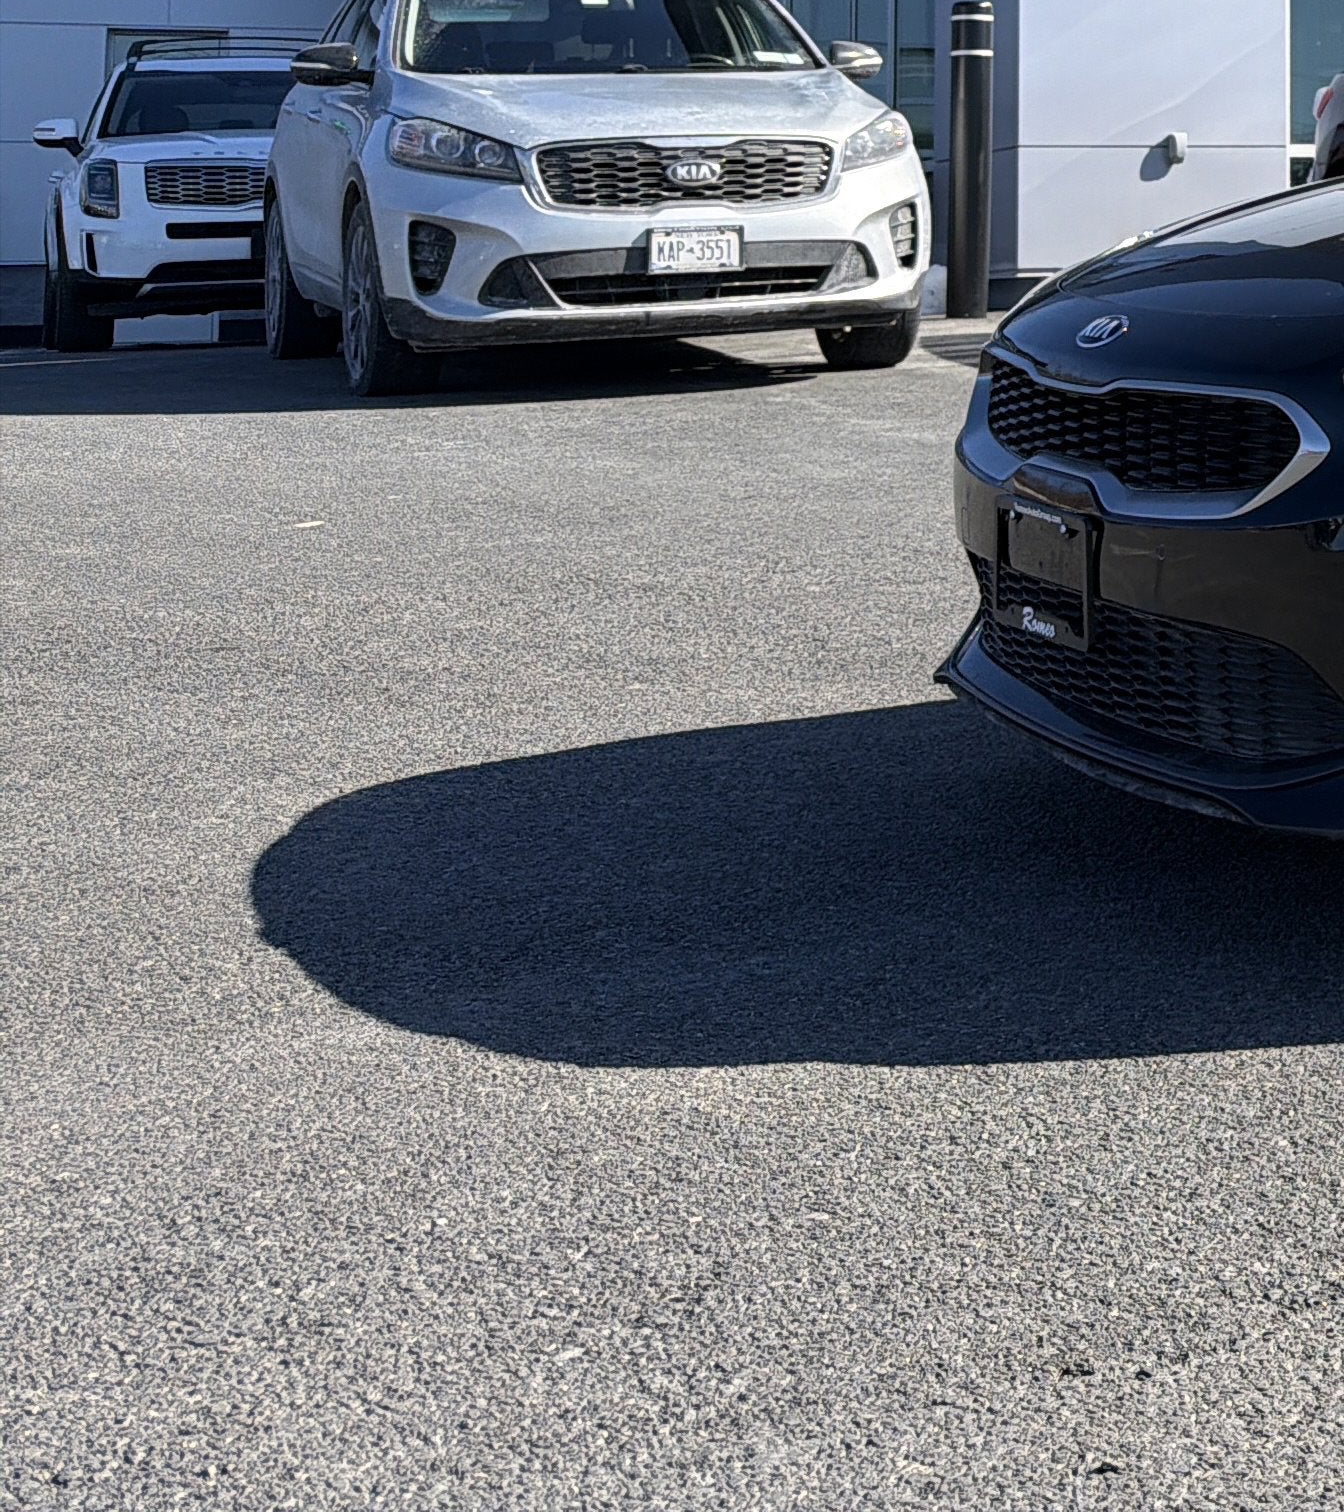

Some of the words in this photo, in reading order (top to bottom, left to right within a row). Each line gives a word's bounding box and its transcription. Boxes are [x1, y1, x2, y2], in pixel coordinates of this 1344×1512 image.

[676, 165, 712, 180] KIA
[1080, 318, 1120, 339] KIA
[1022, 606, 1056, 639] Romeo
